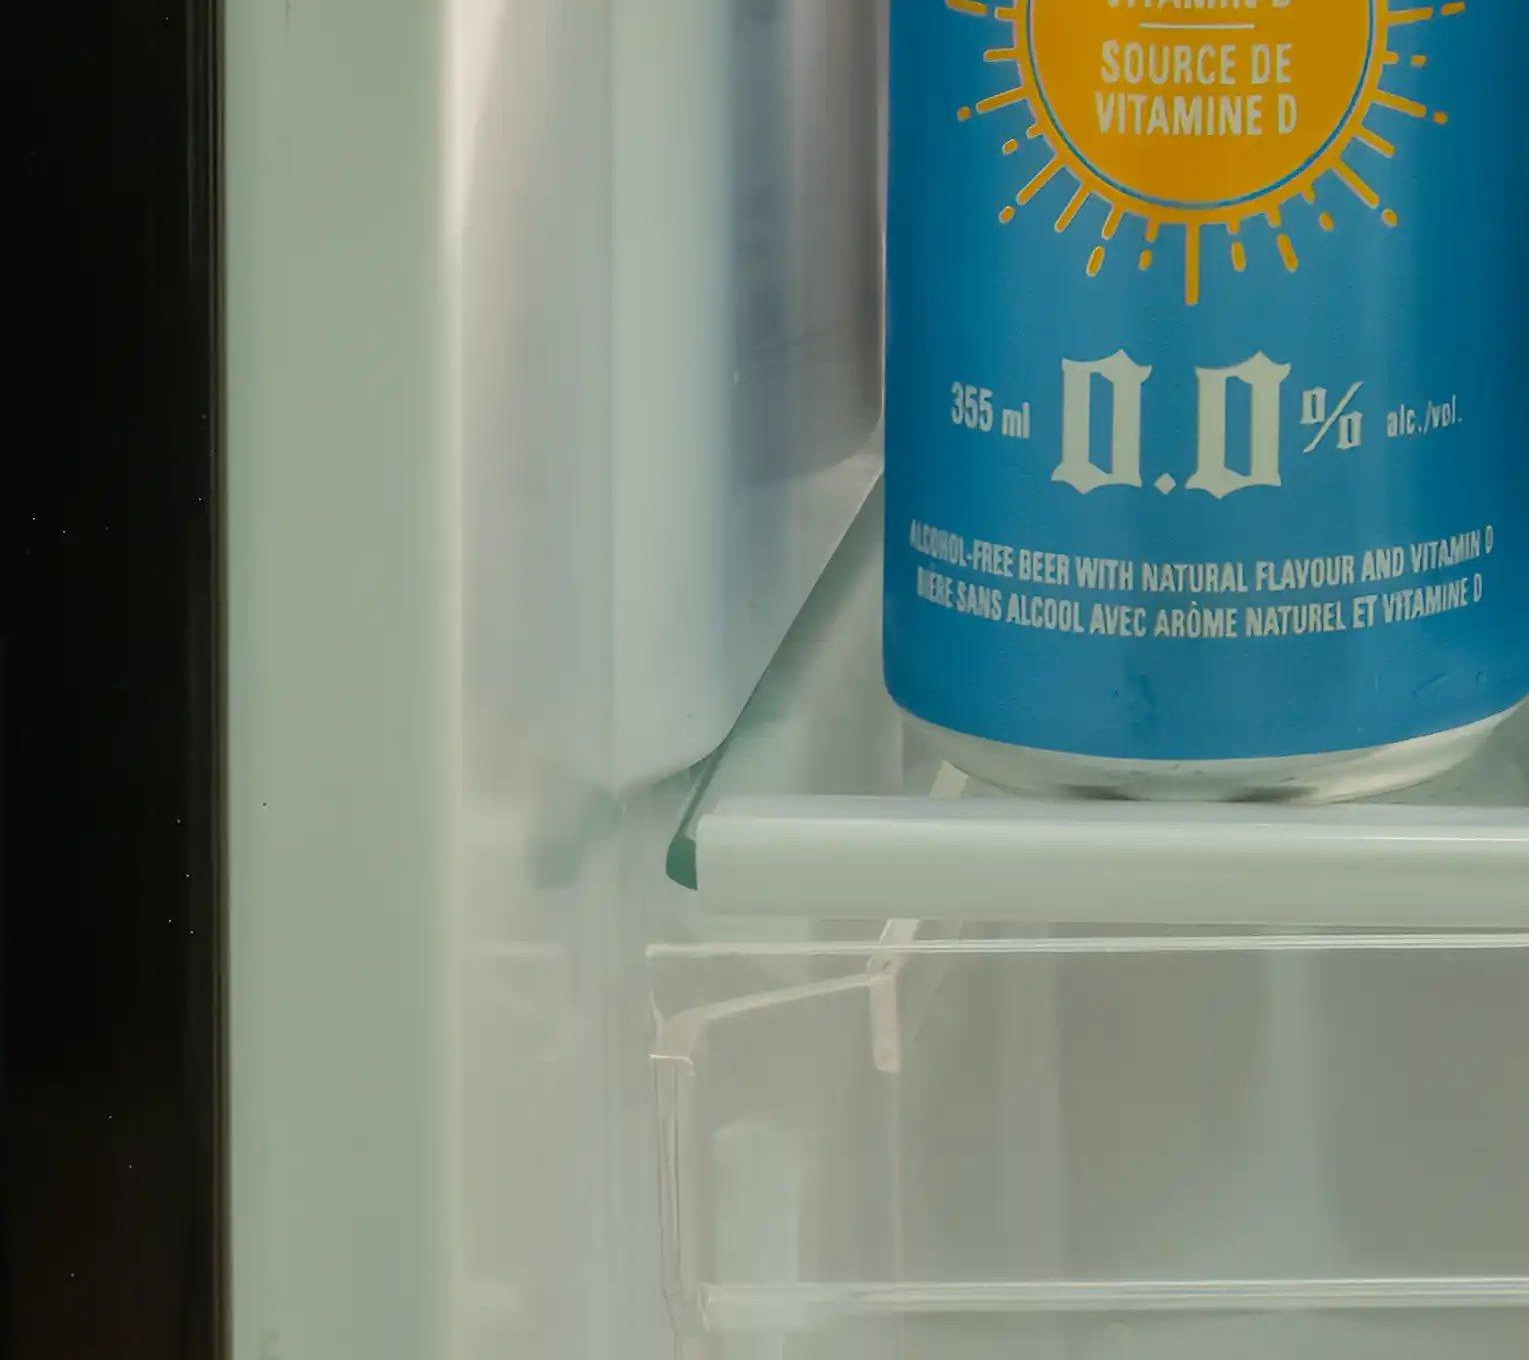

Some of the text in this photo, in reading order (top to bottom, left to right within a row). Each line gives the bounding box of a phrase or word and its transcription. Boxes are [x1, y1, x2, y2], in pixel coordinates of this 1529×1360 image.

[1100, 41, 1293, 88] SOURCE DE
[1095, 90, 1299, 137] VITAMINE D
[950, 381, 994, 433] 355
[1001, 401, 1031, 441] ml
[1386, 395, 1465, 438] alc./vol.
[1018, 546, 1070, 587] BEER
[1075, 555, 1135, 592] WITH
[1142, 559, 1249, 593] NATURAL
[1255, 555, 1355, 593] FLAVOUR
[1361, 545, 1404, 581] AND
[1410, 529, 1481, 573] VITAMIN
[1484, 524, 1494, 555] D
[956, 579, 1002, 622] SANS
[1006, 591, 1086, 636] ALCOOL
[1090, 602, 1147, 638] AVEC
[1244, 596, 1346, 638] NATUREL
[1351, 592, 1380, 629] ET
[1382, 580, 1470, 624] VITAMINE
[1473, 571, 1483, 605] D
